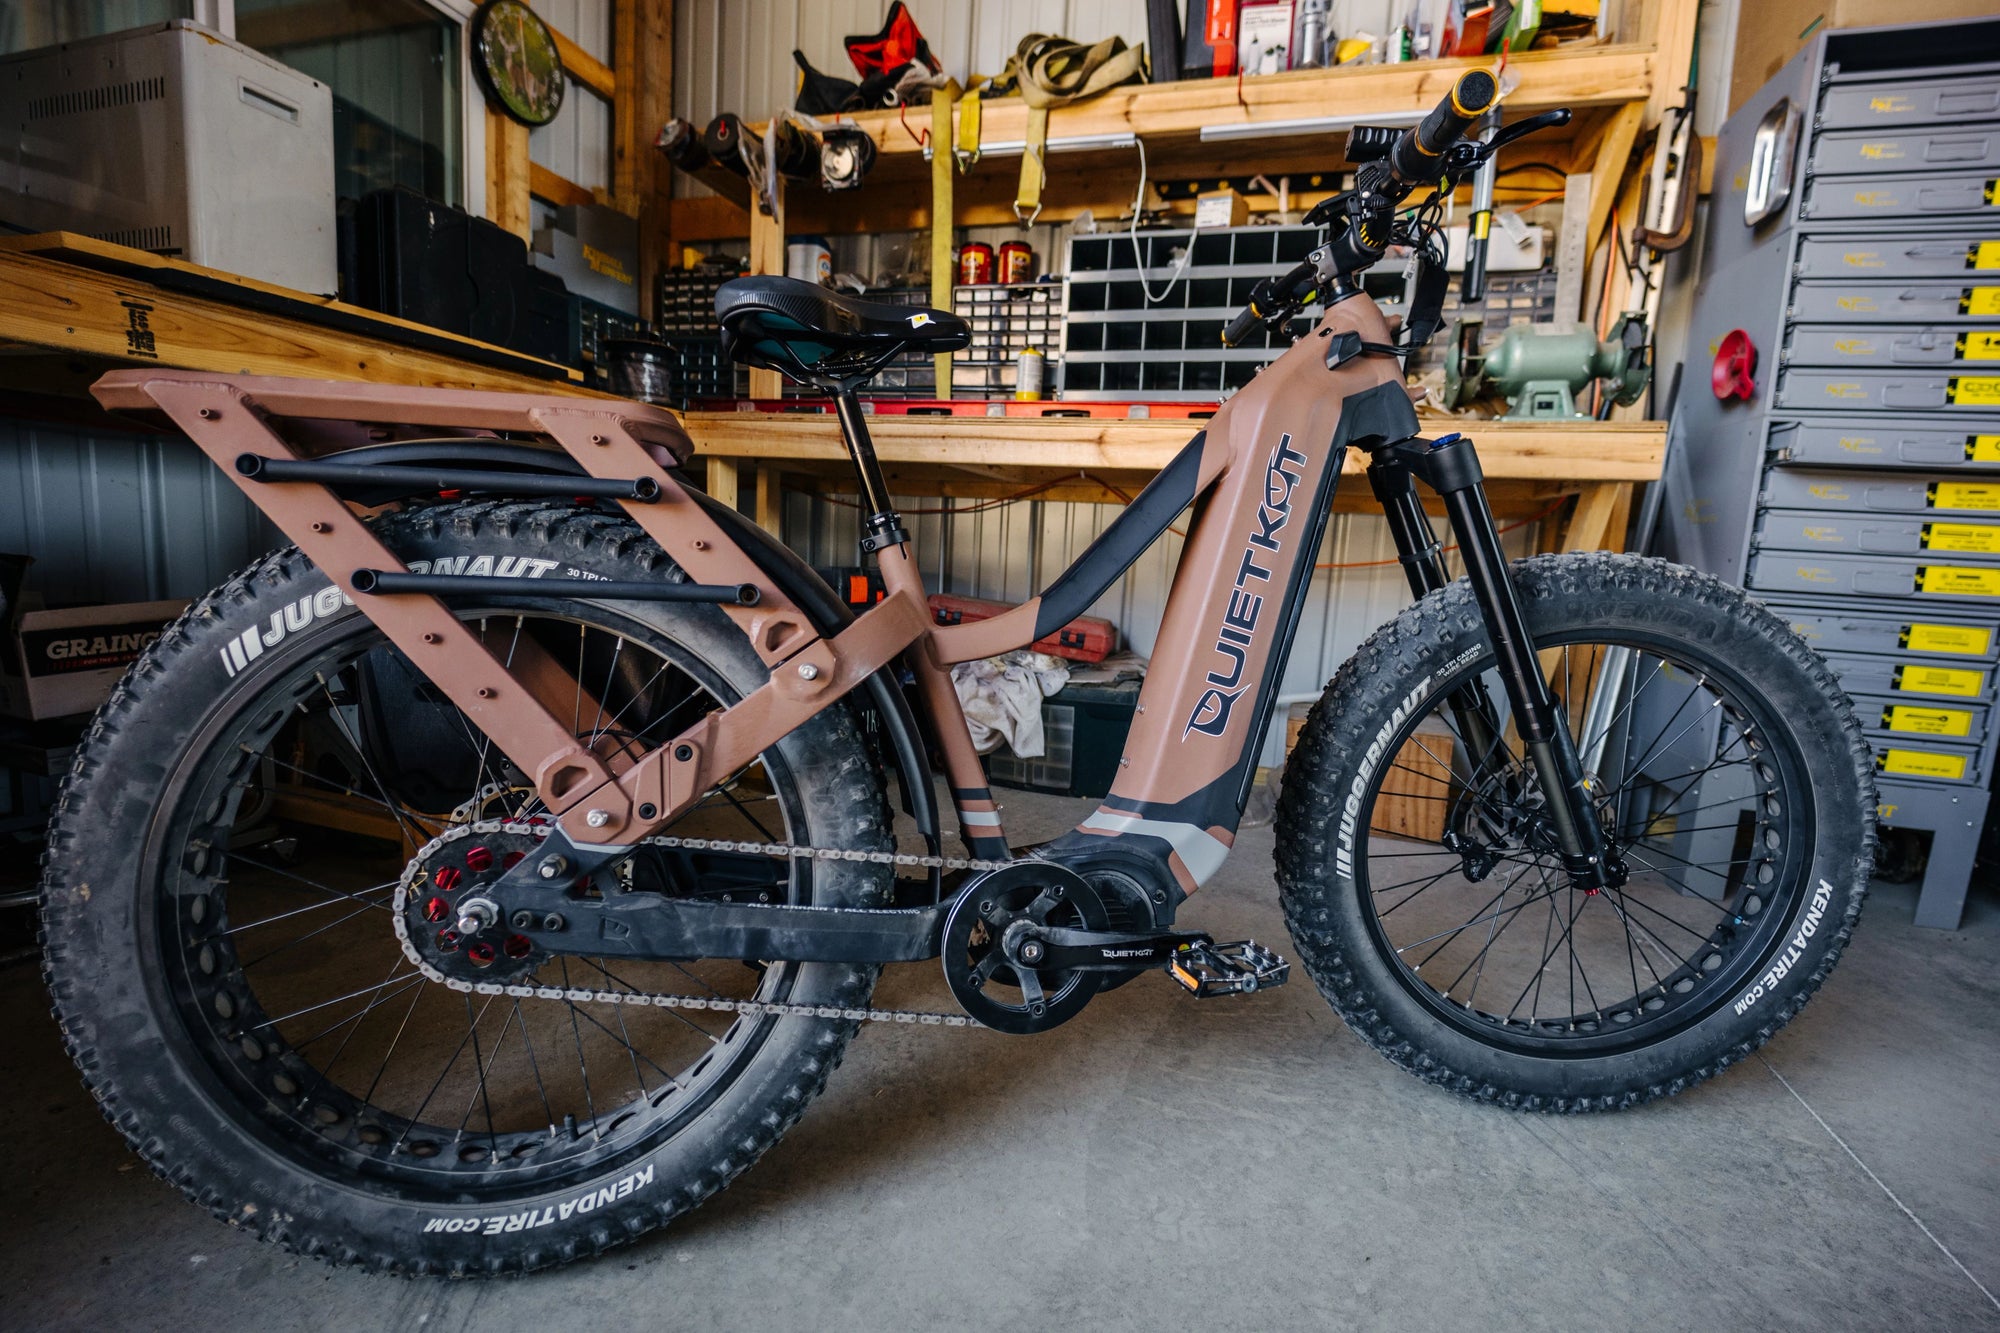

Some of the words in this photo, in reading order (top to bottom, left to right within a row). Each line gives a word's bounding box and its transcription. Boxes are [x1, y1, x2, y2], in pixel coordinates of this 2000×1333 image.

[567, 568, 580, 577] 30
[582, 571, 599, 581] TPI
[1182, 433, 1307, 743] QUIETKAT
[46, 631, 163, 660] GRAING
[1436, 667, 1445, 677] 30
[1445, 659, 1457, 670] TPI
[1456, 643, 1482, 662] CASING
[1443, 662, 1460, 677] WIRE
[1460, 651, 1479, 665] BEAD
[1338, 675, 1432, 849] JUGGERNAUT
[1734, 878, 1833, 1016] KENDATIRE.COM
[423, 1164, 654, 1236] KENDATIRE.COM
